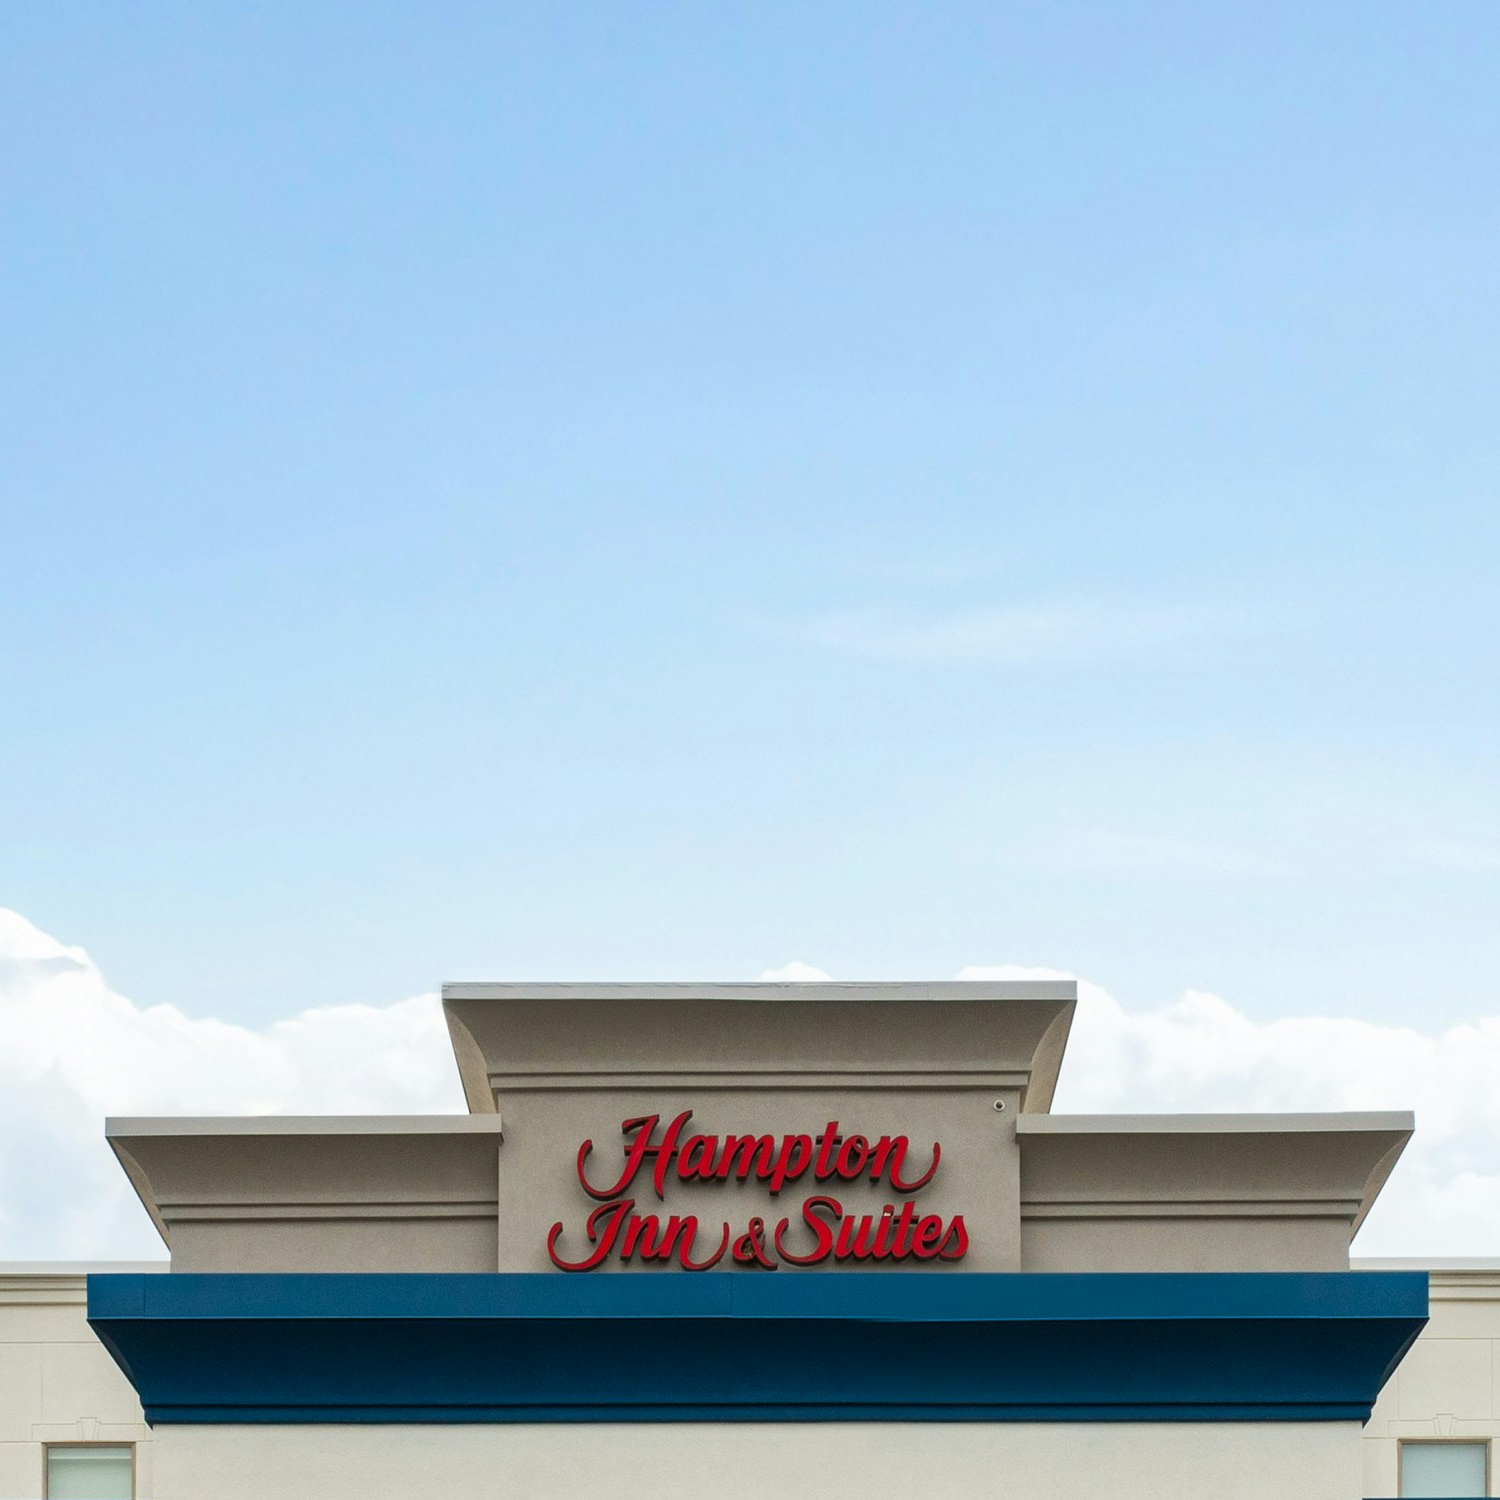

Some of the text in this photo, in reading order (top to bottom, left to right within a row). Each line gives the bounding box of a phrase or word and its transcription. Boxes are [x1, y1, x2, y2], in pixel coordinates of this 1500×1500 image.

[576, 1110, 941, 1200] Hampton
[547, 1196, 970, 1271] Inn & Suites
